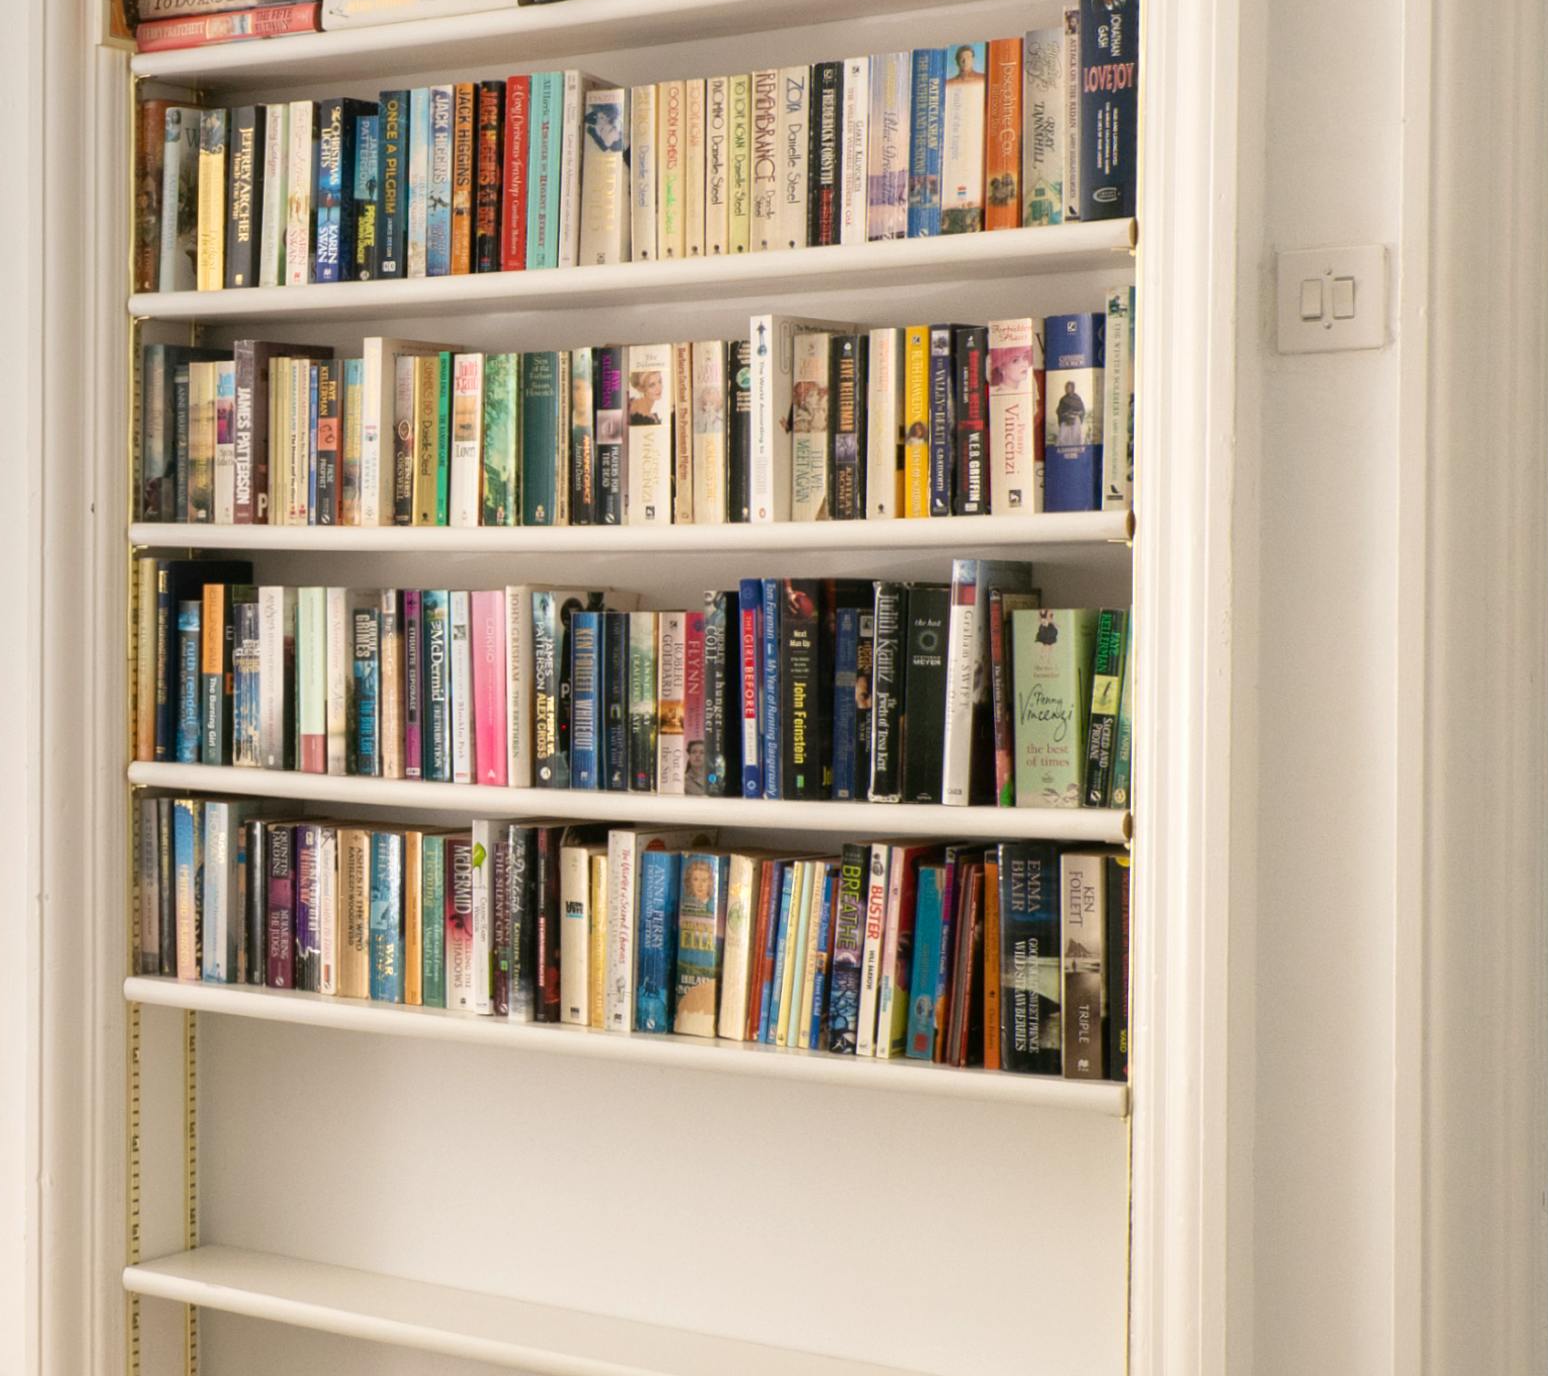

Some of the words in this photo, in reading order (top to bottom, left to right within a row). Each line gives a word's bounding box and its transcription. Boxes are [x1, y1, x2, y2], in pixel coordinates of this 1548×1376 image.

[1098, 25, 1108, 48] GASH
[1110, 14, 1122, 57] JONATHAN
[1000, 62, 1017, 128] Josephine
[1083, 63, 1135, 93] LOVEJOY
[386, 100, 398, 140] ONCE
[434, 95, 449, 129] JACK
[754, 73, 775, 184] REMEMBRANCE
[821, 89, 835, 141] FREDERICK
[240, 128, 254, 181] JEFFREY
[321, 128, 331, 169] LIGHTS
[359, 121, 370, 190] PATTERSON
[368, 136, 377, 173] JAMES
[387, 144, 397, 153] A
[711, 136, 723, 175] Danielle
[787, 124, 802, 167] Danielle
[928, 123, 938, 150] SHAW
[1001, 129, 1016, 157] Cox
[432, 133, 446, 184] HIGGINS
[821, 142, 835, 185] FORSYTH
[385, 158, 398, 213] PILGRIM
[711, 176, 723, 206] Steel
[787, 172, 801, 204] Steel
[238, 181, 252, 242] ARCHER
[365, 205, 375, 247] PRIVATE
[318, 227, 329, 263] SWAN
[328, 224, 338, 264] KAREN
[840, 359, 854, 378] FAYE
[237, 387, 251, 428] JAMES
[840, 382, 854, 432] KELLERMAN
[968, 432, 979, 459] W.E.B.
[1004, 404, 1019, 476] Vincenzi
[236, 432, 250, 504] PATTERSON
[968, 461, 979, 501] GRIFFIN
[510, 593, 519, 625] JOHN
[767, 583, 775, 599] Tom
[767, 602, 776, 639] Foreman
[878, 592, 899, 634] Judith
[186, 641, 197, 671] ruth
[355, 614, 370, 658] GRIMES
[511, 627, 520, 682] GRISHAM
[536, 621, 545, 690] PATTERSON
[575, 628, 593, 651] KEN
[705, 625, 716, 664] COLE
[744, 634, 754, 663] GIRL
[1098, 613, 1111, 672] KELLERMAN
[430, 629, 444, 702] McDermid
[545, 638, 553, 677] JAMES
[574, 653, 594, 693] FOLLETT
[661, 634, 673, 697] GODDARD
[673, 642, 683, 688] ROBERT
[688, 640, 699, 694] FLYNN
[767, 659, 776, 672] My
[876, 638, 898, 683] Krantz
[186, 676, 196, 726] rendell
[209, 677, 217, 693] The
[714, 681, 725, 725] hunger
[745, 666, 755, 714] BEFORE
[767, 674, 776, 693] Year
[767, 695, 776, 704] of
[793, 682, 806, 708] John
[207, 695, 217, 728] Burning
[537, 693, 547, 721] ALEX
[574, 699, 593, 751] WHITEOUT
[705, 699, 714, 733] other
[766, 705, 777, 740] Running
[209, 730, 217, 747] Girl
[537, 723, 547, 759] CROSS
[662, 747, 671, 762] the
[793, 711, 806, 764] Feinstein
[661, 765, 670, 786] Sun
[673, 749, 682, 768] Out
[673, 772, 682, 782] of
[272, 831, 280, 876] JARDINE
[280, 831, 288, 876] QUINTIN
[495, 851, 504, 874] THE
[356, 885, 363, 899] IN
[453, 844, 472, 914] McDERMID
[495, 877, 504, 918] SILENT
[654, 864, 665, 904] ANNE
[1011, 860, 1024, 912] BLAIR
[1027, 860, 1040, 912] EMMA
[1084, 886, 1095, 912] KEN
[272, 912, 280, 925] THE
[837, 865, 861, 951] BREATHE
[867, 885, 883, 940] BUSTER
[1069, 871, 1082, 928] FOLLETT
[271, 927, 280, 958] JUDGES
[495, 921, 504, 945] CRY
[653, 910, 664, 951] PERRY
[385, 943, 394, 976] WAR
[454, 938, 463, 988] SHADOWS
[1015, 941, 1026, 972] WILD
[1015, 972, 1026, 1051] STRAWBERRIES
[1078, 1005, 1089, 1043] TRIPLE
